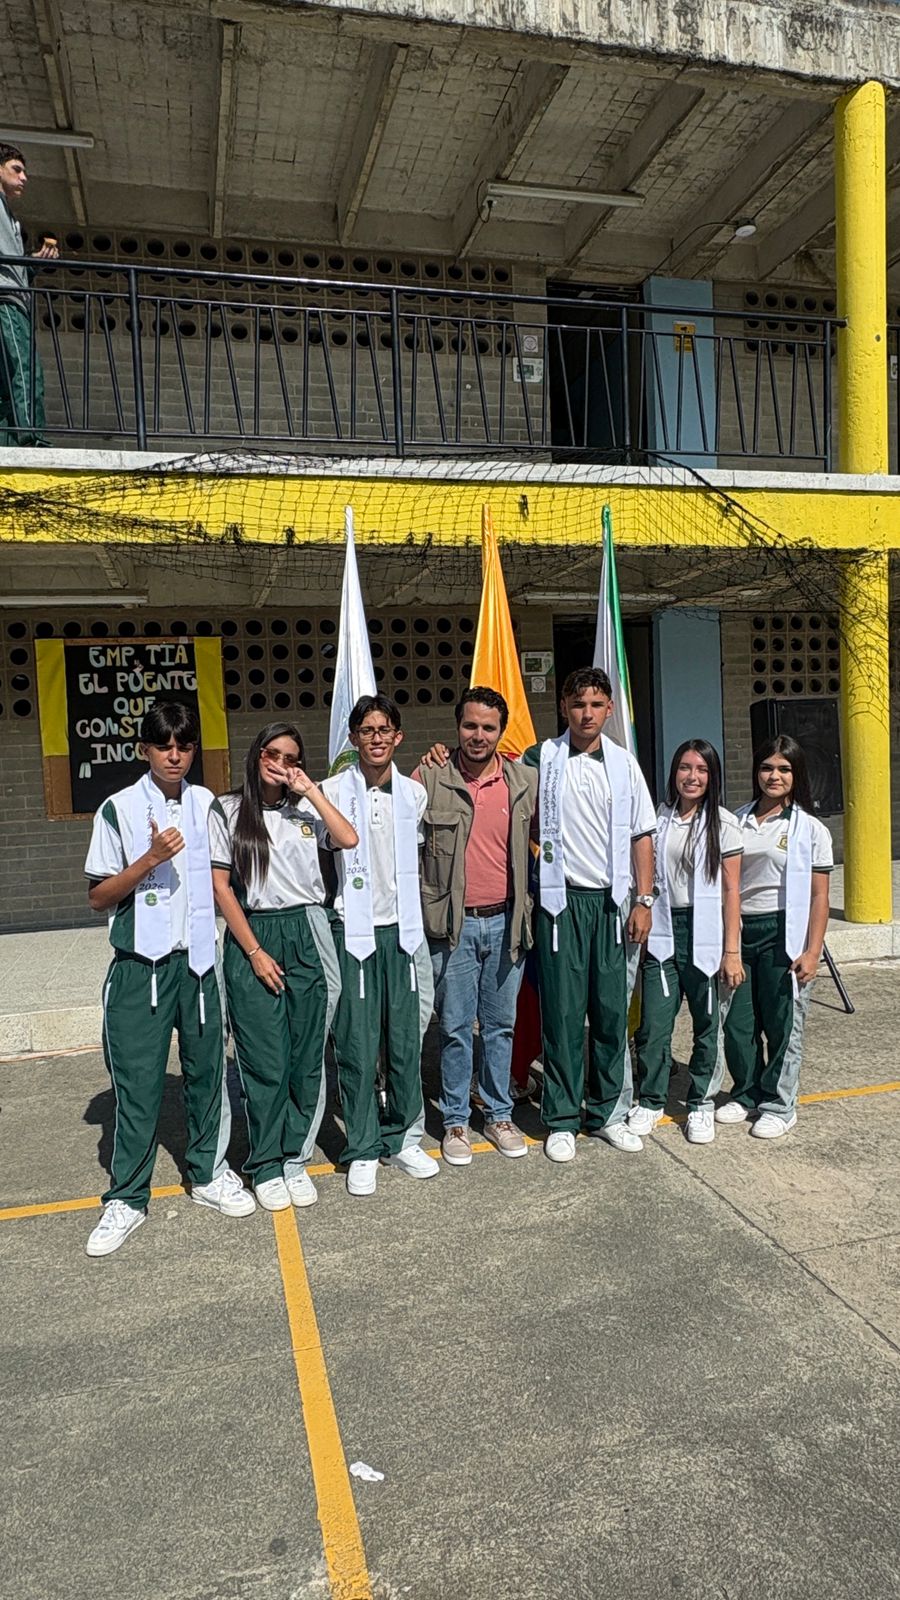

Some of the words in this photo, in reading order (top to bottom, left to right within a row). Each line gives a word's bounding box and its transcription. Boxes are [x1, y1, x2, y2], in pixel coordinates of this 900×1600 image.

[78, 673, 109, 695] EL
[116, 670, 198, 692] PUENTE
[346, 866, 368, 875] 2026
